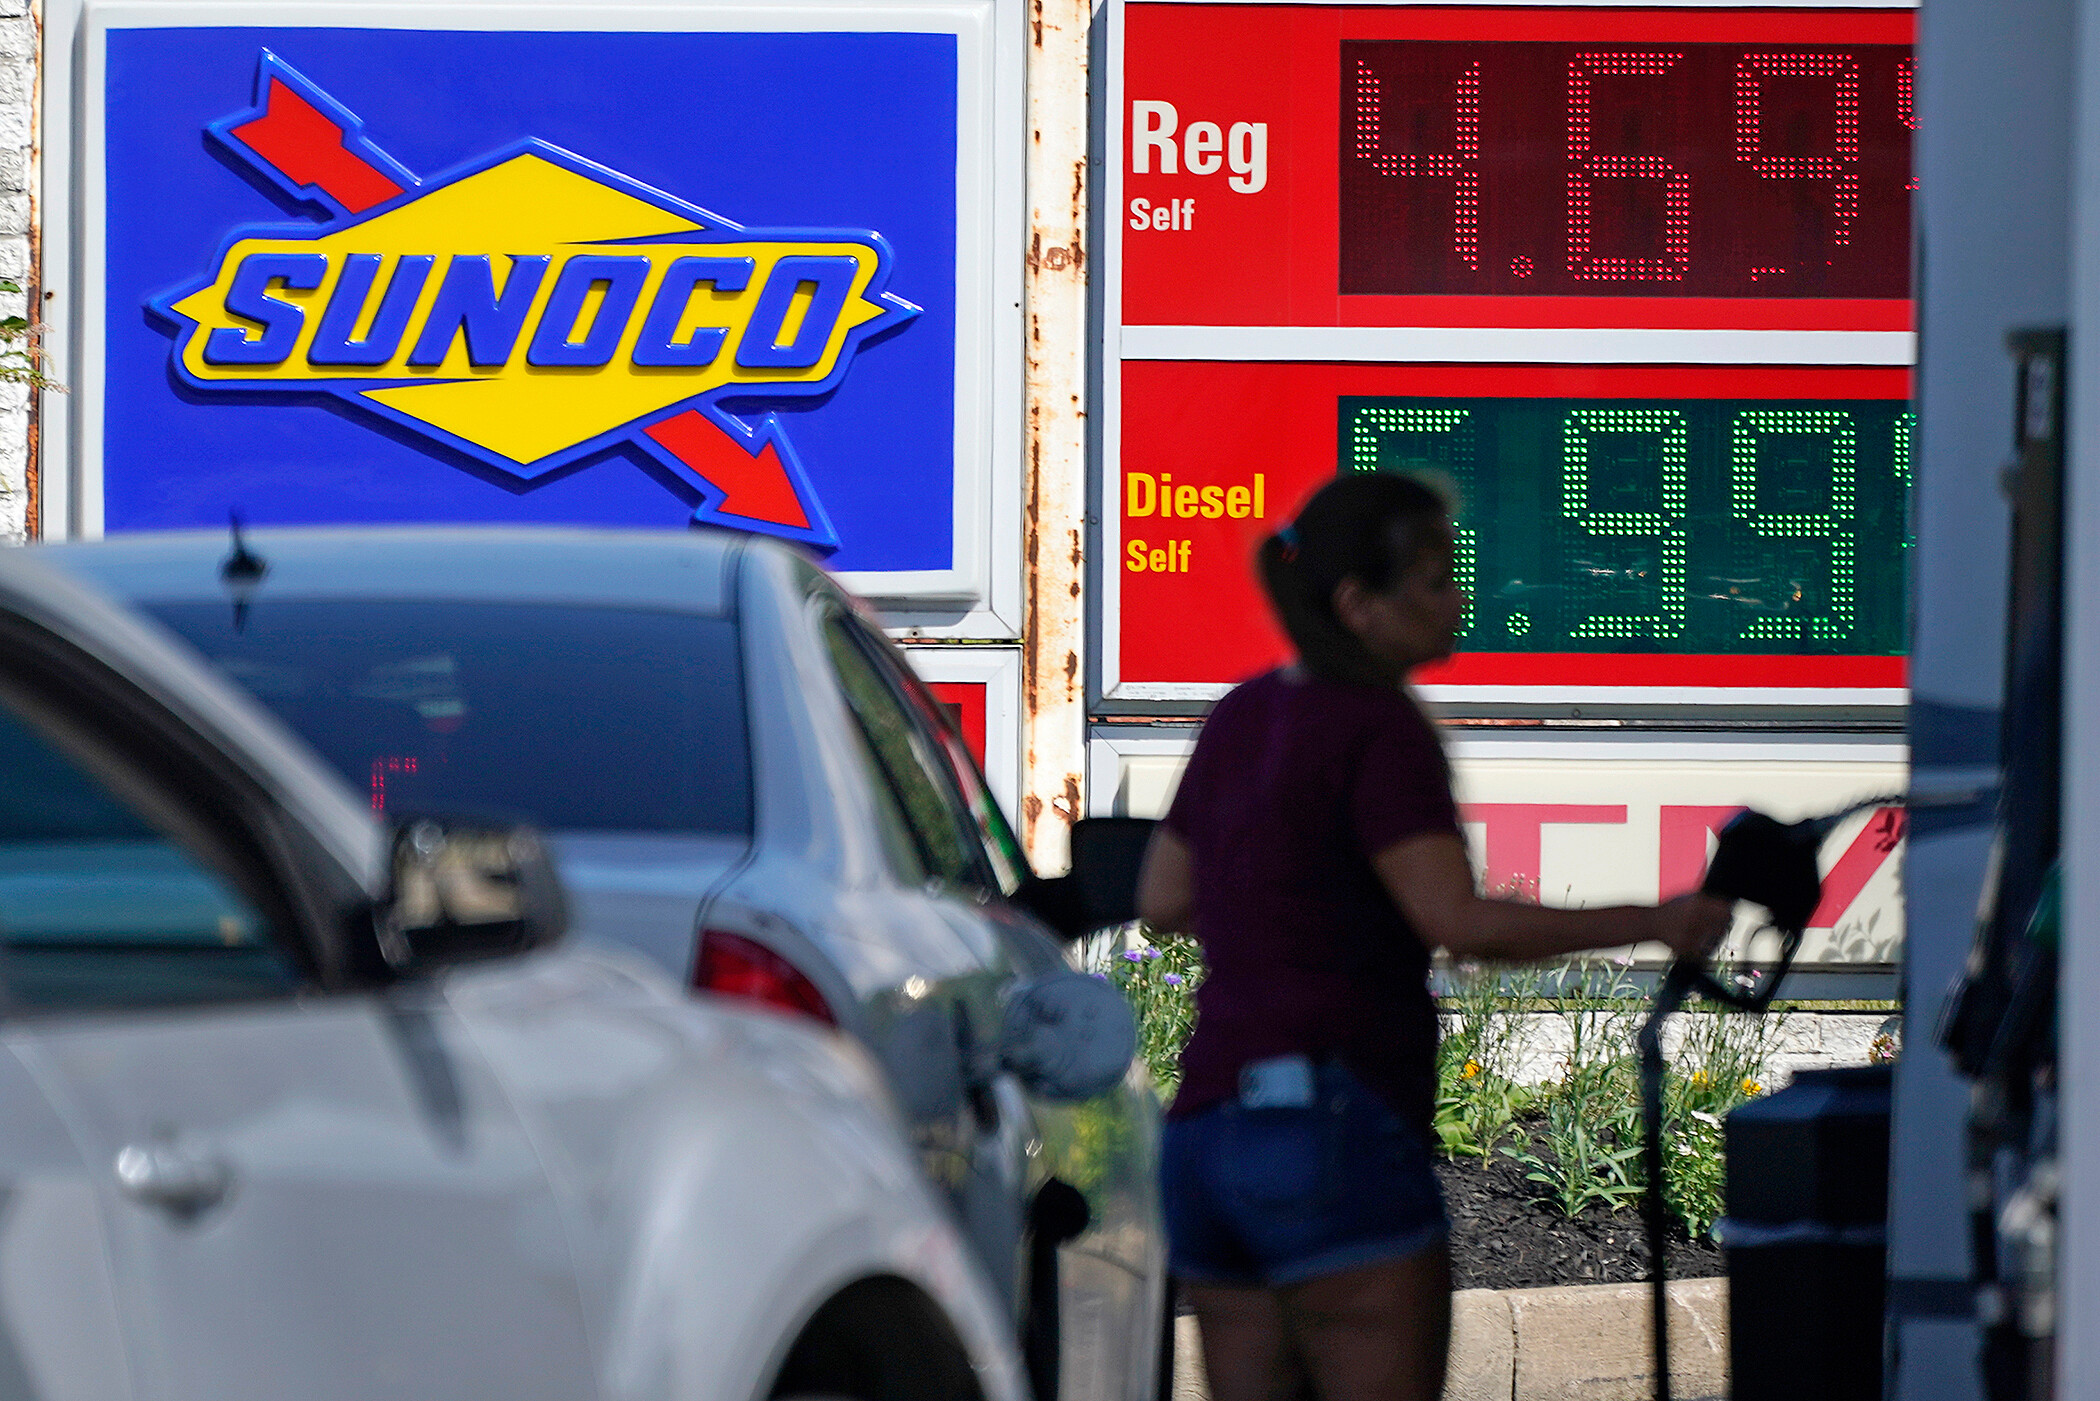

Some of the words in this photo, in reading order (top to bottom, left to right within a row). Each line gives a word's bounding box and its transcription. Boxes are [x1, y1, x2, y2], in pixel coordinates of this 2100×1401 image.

[1132, 100, 1268, 194] Reg
[1129, 197, 1195, 231] Self
[202, 252, 861, 369] SUNOCO
[1127, 472, 1265, 519] Diesel
[1126, 539, 1192, 572] Self
